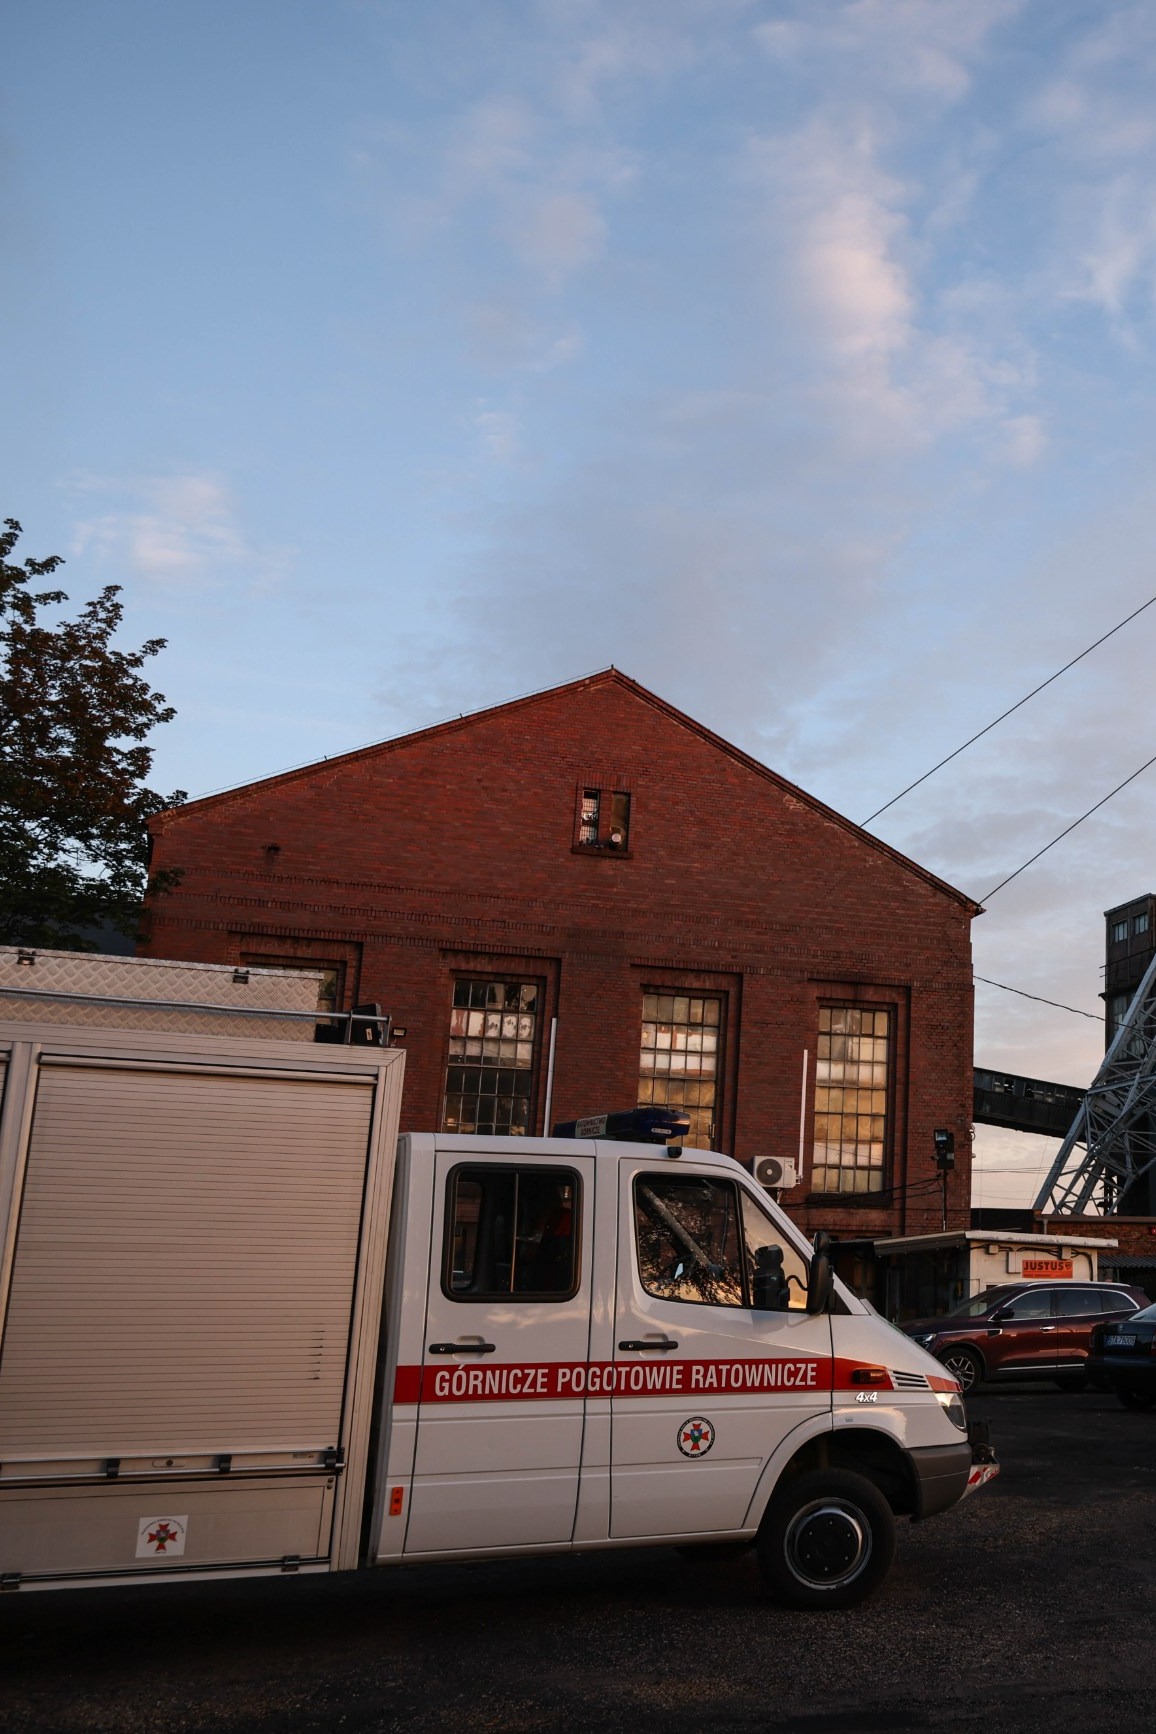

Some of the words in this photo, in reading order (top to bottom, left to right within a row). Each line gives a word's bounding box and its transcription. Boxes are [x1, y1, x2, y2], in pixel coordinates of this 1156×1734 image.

[1024, 1261, 1064, 1270] JUSTUS
[434, 1364, 549, 1397] GÓRNICZE
[557, 1366, 683, 1392] POGOTOWIE
[691, 1363, 817, 1388] RATOWNICZE
[855, 1391, 878, 1403] 4x4
